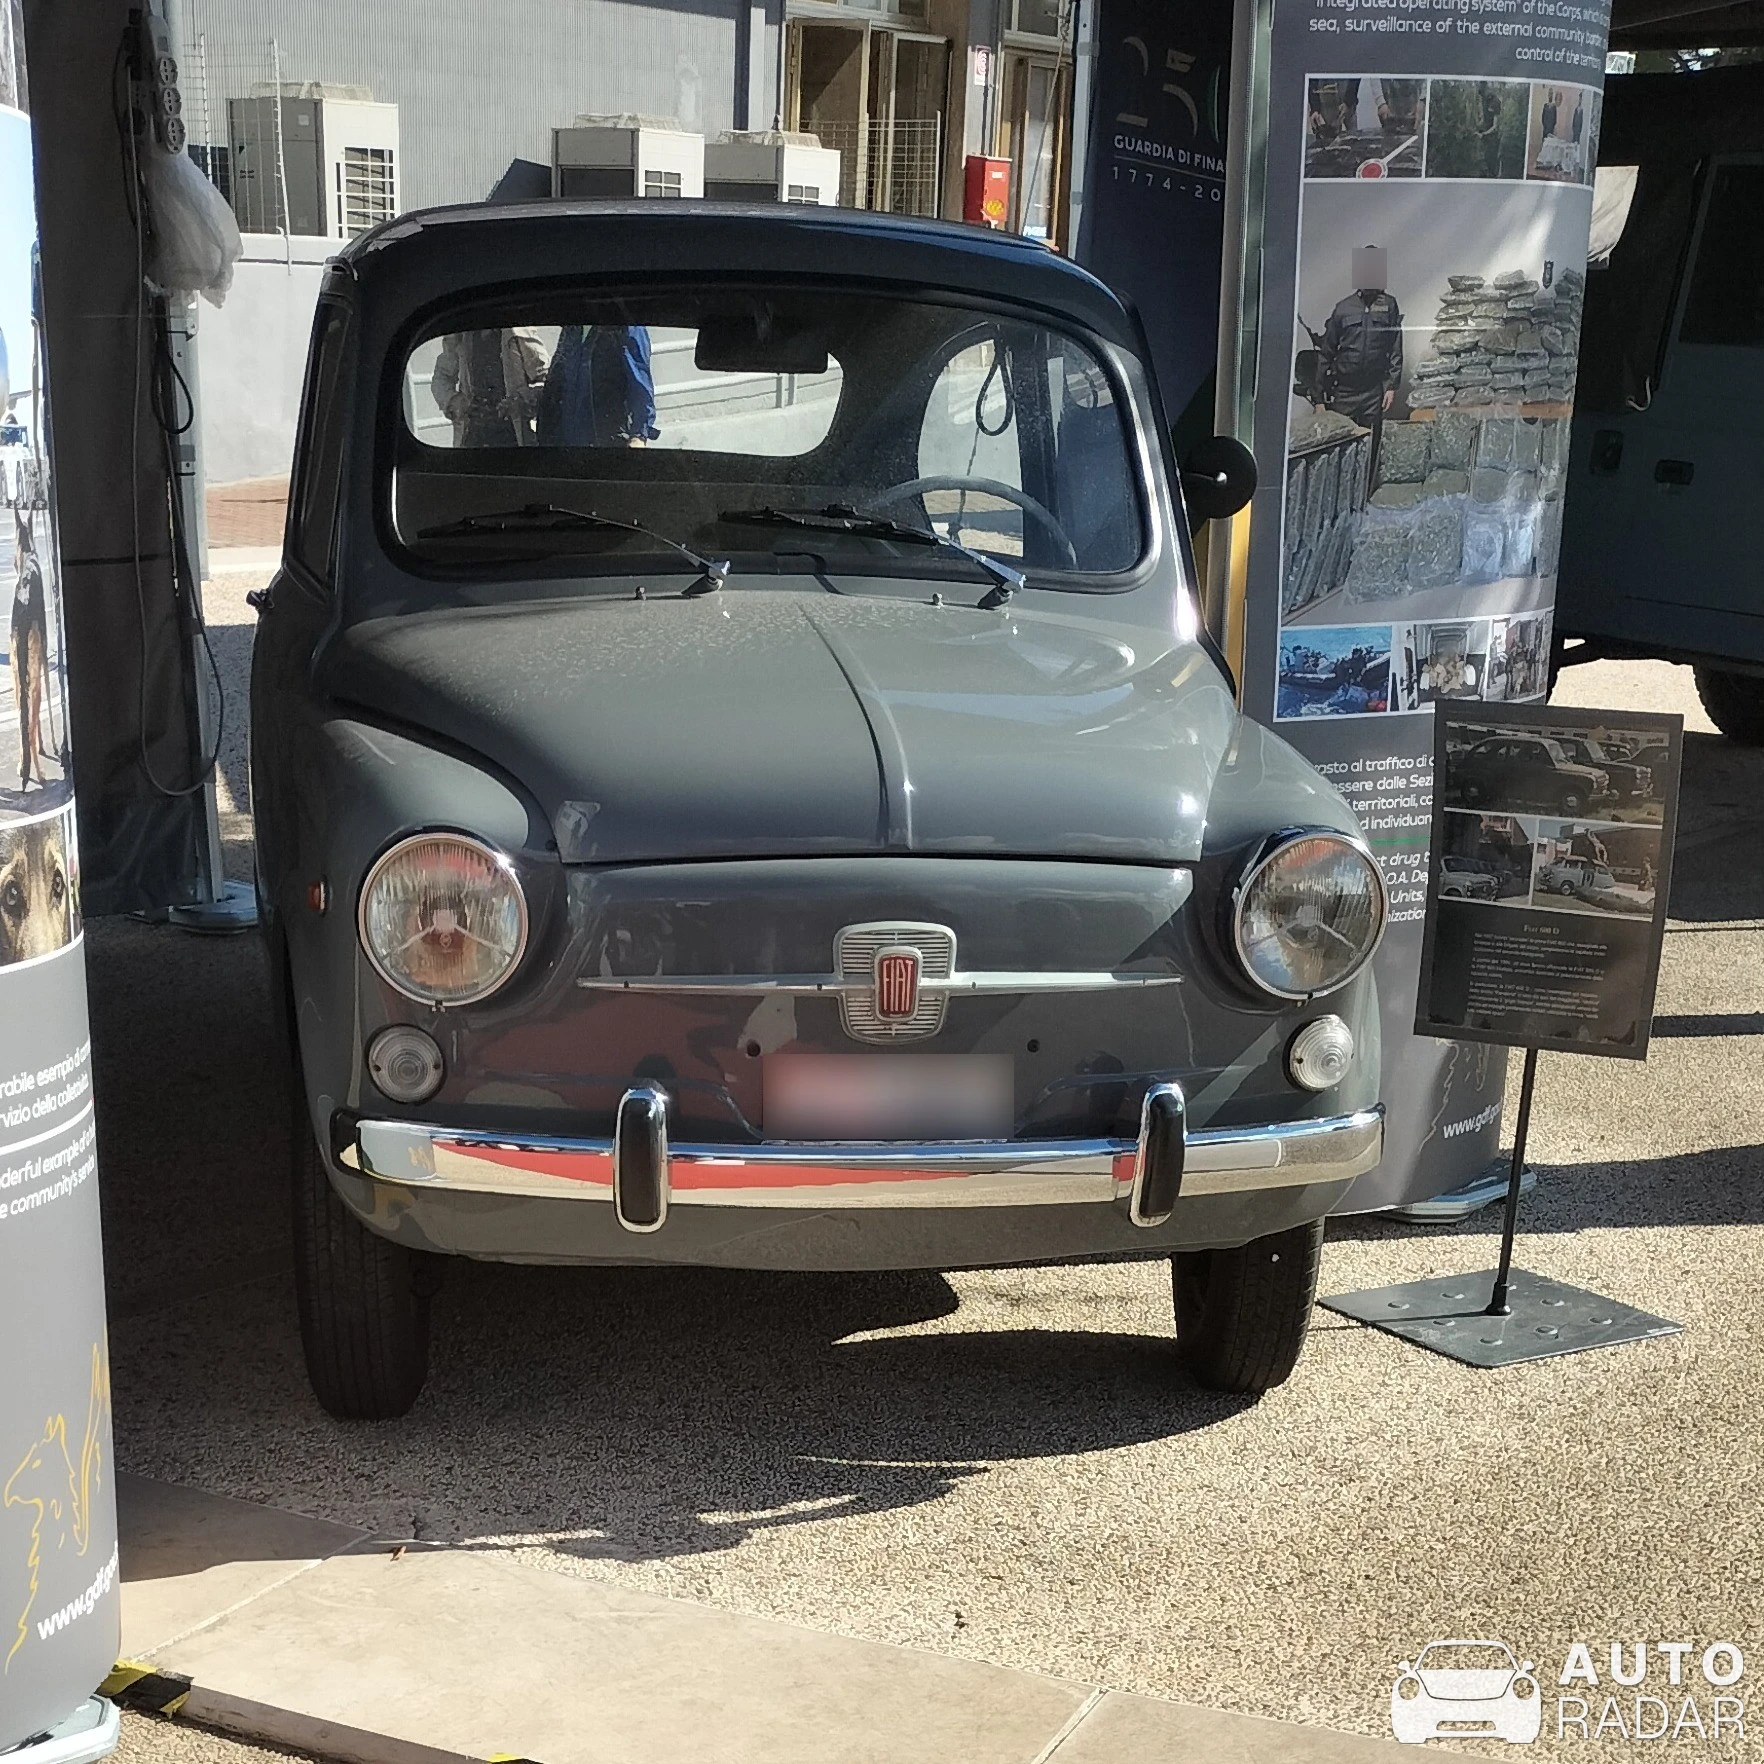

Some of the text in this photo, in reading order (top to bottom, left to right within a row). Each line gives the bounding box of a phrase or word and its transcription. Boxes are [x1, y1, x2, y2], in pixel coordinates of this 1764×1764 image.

[1522, 1, 1535, 14] of
[1537, 2, 1555, 16] the
[1309, 18, 1340, 34] sea,
[1345, 15, 1432, 32] surveillance
[1435, 17, 1453, 33] of
[1456, 18, 1479, 34] the
[1483, 21, 1533, 37] external
[1535, 26, 1585, 46] community
[1515, 47, 1553, 62] control
[1554, 48, 1566, 63] of
[1566, 50, 1580, 65] the
[1114, 134, 1225, 173] GUARDIA DI FINA
[1350, 758, 1363, 773] al
[1365, 756, 1415, 772] traffico
[1416, 753, 1427, 768] di
[1376, 775, 1407, 790] dalle
[1352, 793, 1419, 812] territoriali,
[1390, 852, 1421, 868] drug
[1390, 888, 1424, 904] Units,
[883, 959, 914, 1012] FIAT
[36, 1053, 74, 1087] esempio
[31, 1093, 58, 1119] della
[0, 1156, 42, 1190] derful
[42, 1139, 80, 1174] example
